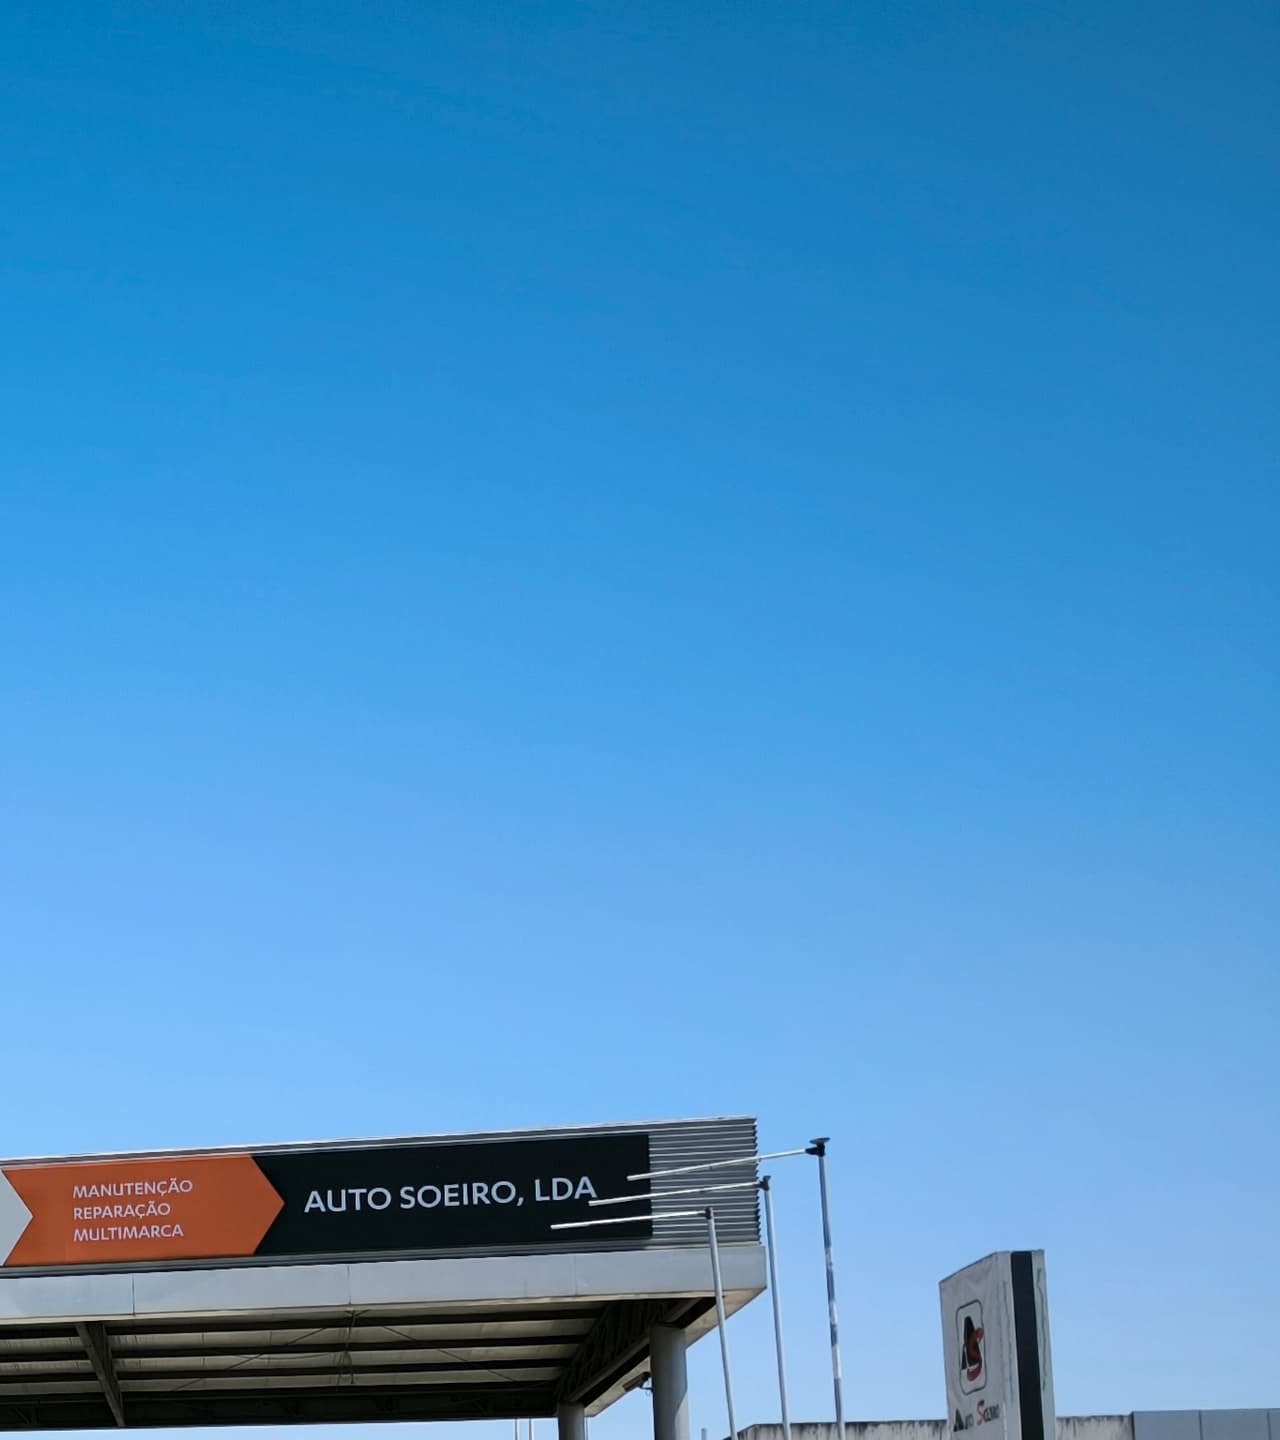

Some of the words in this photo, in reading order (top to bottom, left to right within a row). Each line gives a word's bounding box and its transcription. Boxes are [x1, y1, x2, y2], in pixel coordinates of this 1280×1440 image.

[73, 1178, 193, 1199] MANUTENÇÃO
[304, 1186, 391, 1213] AUTO
[400, 1181, 524, 1210] SOEIRO,
[535, 1176, 598, 1202] LDA
[73, 1201, 171, 1220] REPARAÇÃO
[73, 1224, 184, 1242] MULTIMARCA
